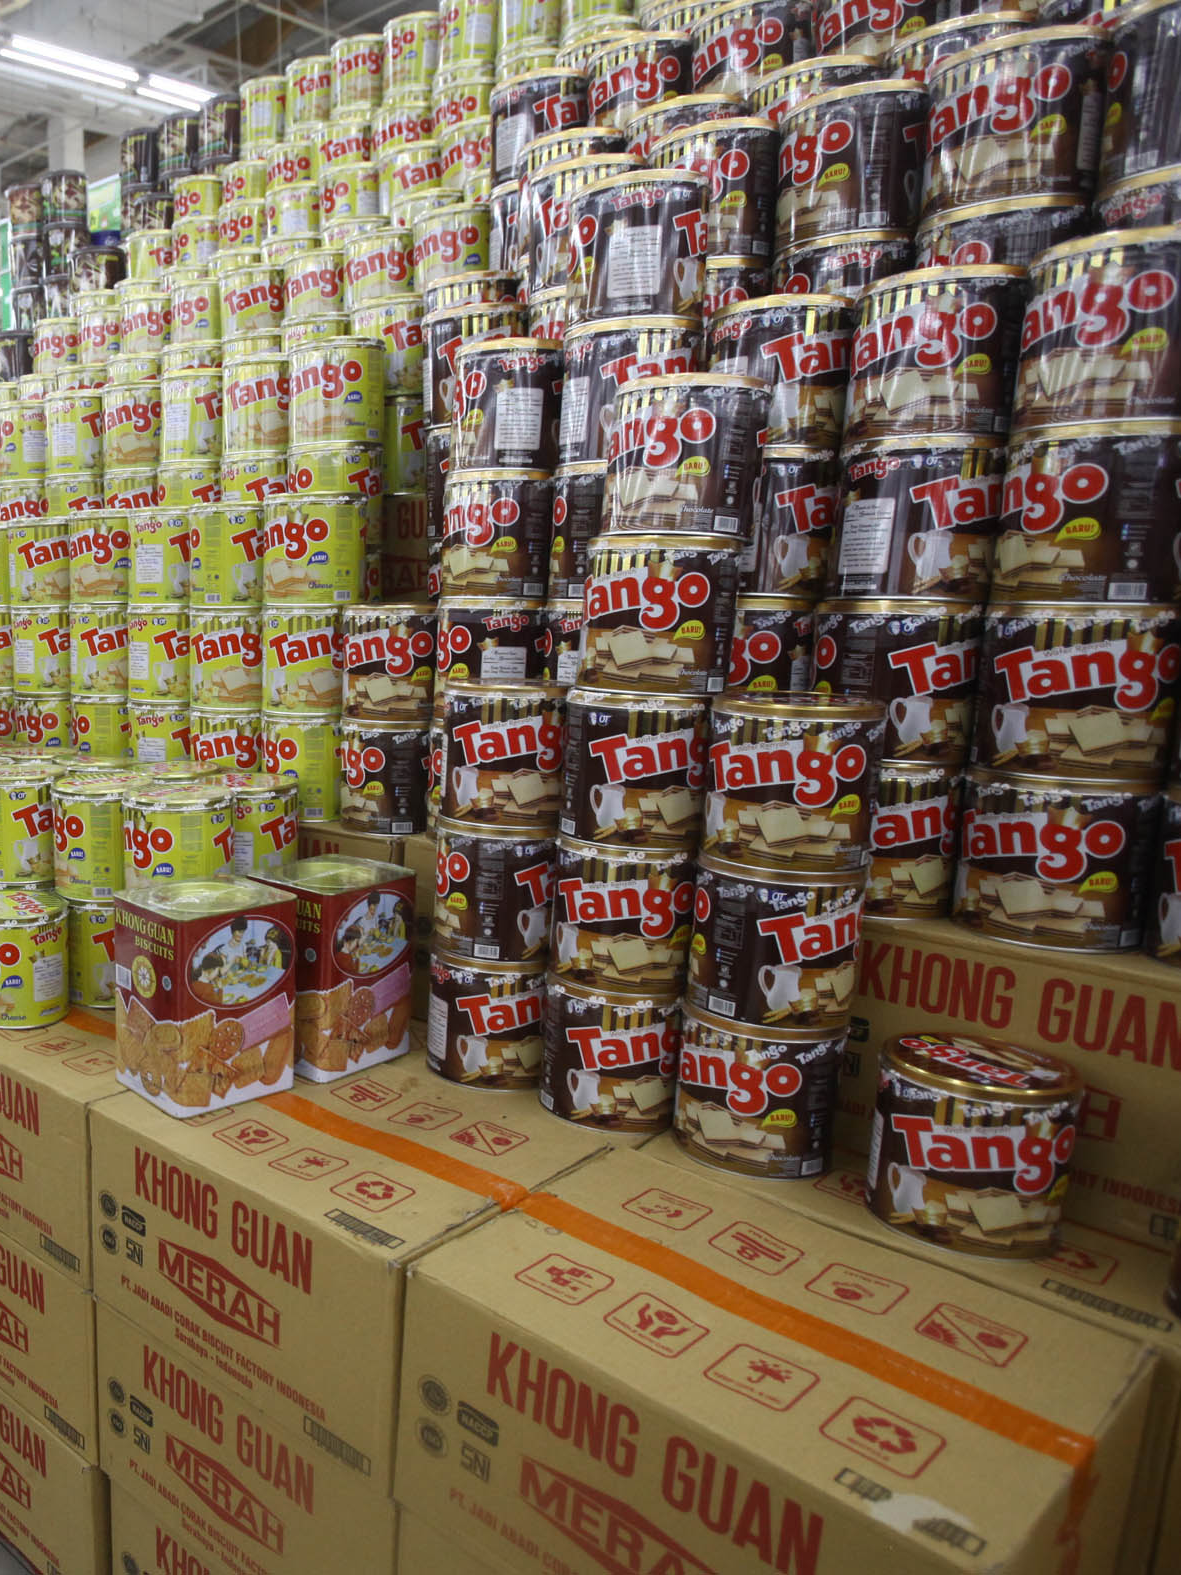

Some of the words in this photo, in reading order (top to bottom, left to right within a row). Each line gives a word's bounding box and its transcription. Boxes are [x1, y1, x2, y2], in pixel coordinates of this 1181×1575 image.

[692, 17, 784, 90] ango
[1022, 270, 1176, 350] ango
[289, 360, 362, 399] ango
[608, 408, 717, 467] ango
[683, 461, 708, 472] BARU!
[264, 519, 329, 559] ango
[443, 497, 519, 545] ango
[19, 540, 69, 569] Tan
[484, 615, 528, 631] Tango
[680, 626, 703, 637] BARU!
[191, 631, 262, 668] Tang
[270, 632, 343, 669] Tang
[191, 733, 256, 769] Tang
[454, 720, 564, 770] Tang
[590, 731, 709, 787] Tang
[710, 741, 866, 807] Tango
[116, 909, 146, 936] KHONG
[147, 921, 175, 947] GUAN
[297, 900, 322, 920] UAN
[560, 878, 694, 938] Tango
[30, 926, 63, 945] Tango
[134, 938, 175, 961] BISCUITS
[758, 906, 860, 965] Tan
[859, 940, 1016, 1029] KHONG
[456, 994, 540, 1036] Tan
[567, 1025, 681, 1074] Tang
[680, 1050, 802, 1115] ango
[893, 1115, 1075, 1194] Tango
[135, 1146, 218, 1239] KHONG
[231, 1200, 313, 1295] GUAN
[158, 1241, 280, 1346] MERAH
[486, 1331, 639, 1478] KHONG
[144, 1345, 223, 1445] KHONG
[236, 1413, 314, 1516] GUAN
[166, 1434, 284, 1553] MERAH
